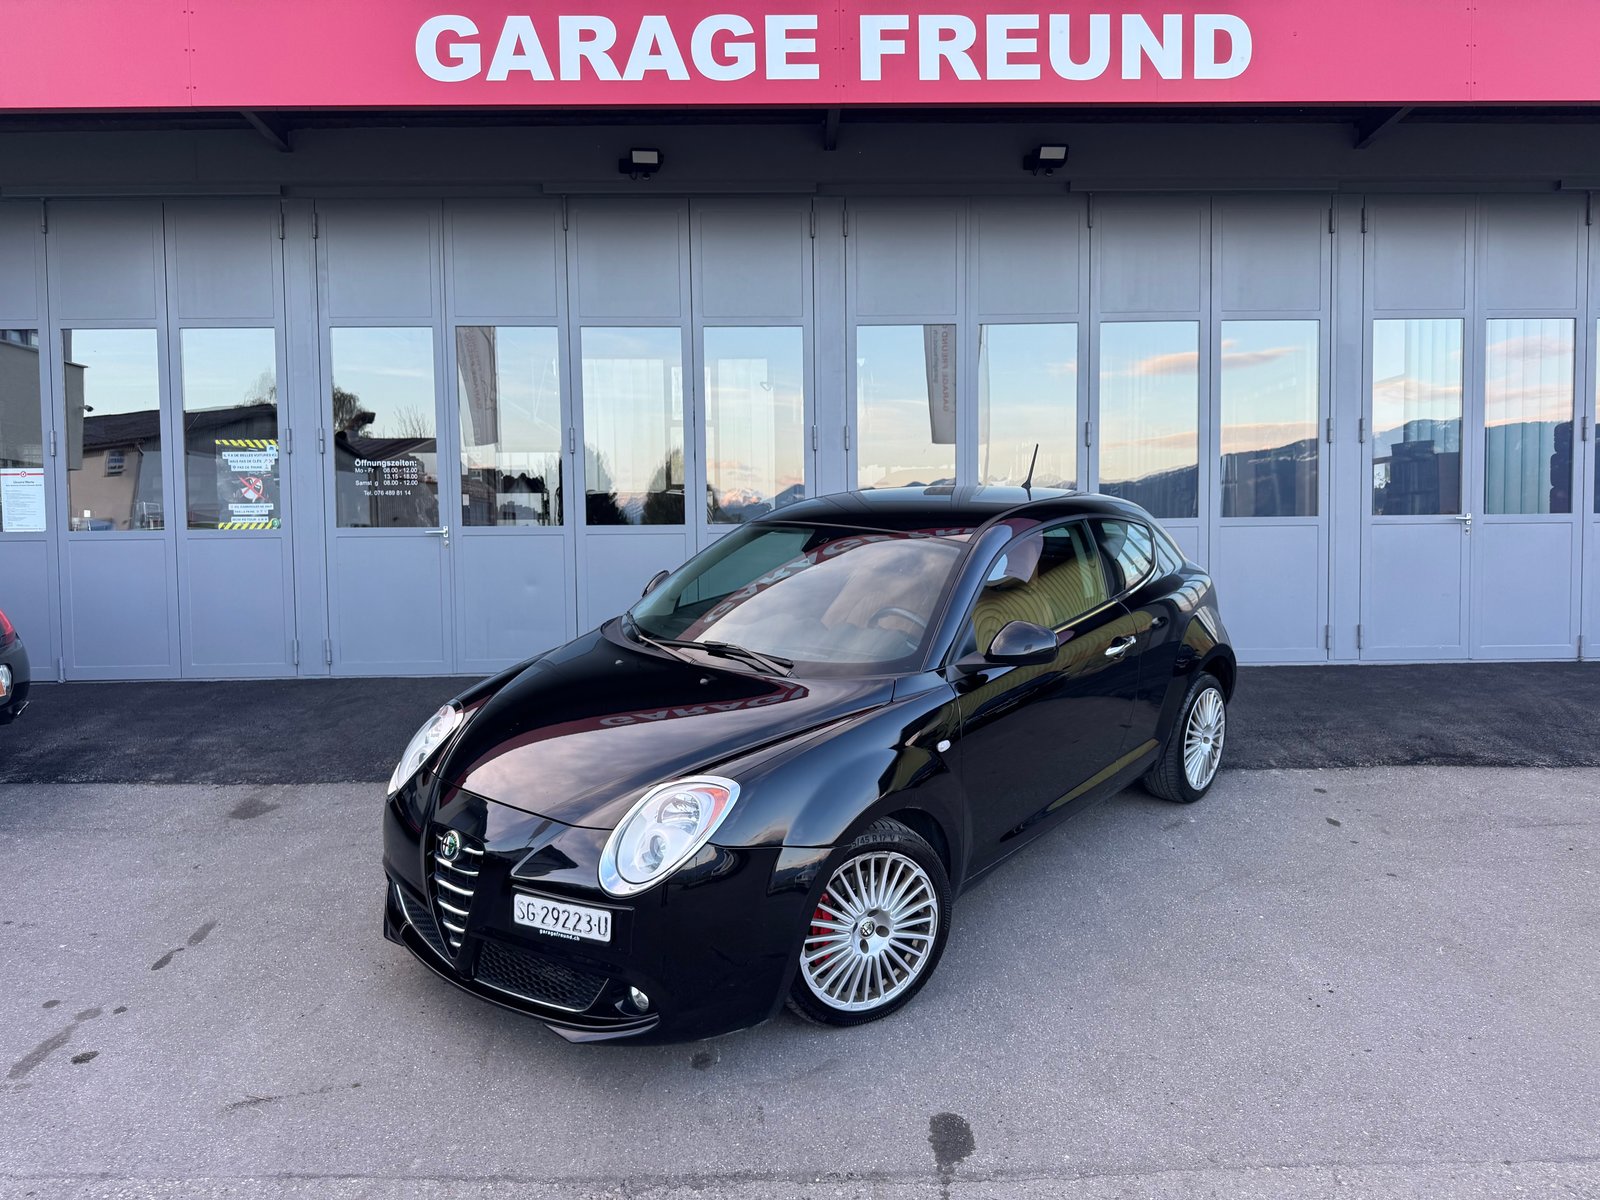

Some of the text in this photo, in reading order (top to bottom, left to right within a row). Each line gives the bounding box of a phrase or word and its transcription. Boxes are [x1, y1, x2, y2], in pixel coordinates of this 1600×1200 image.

[415, 14, 1253, 82] GARAGE FREUND
[354, 458, 417, 468] Öffnungszeiten:
[539, 929, 581, 941] garagefreund.ch
